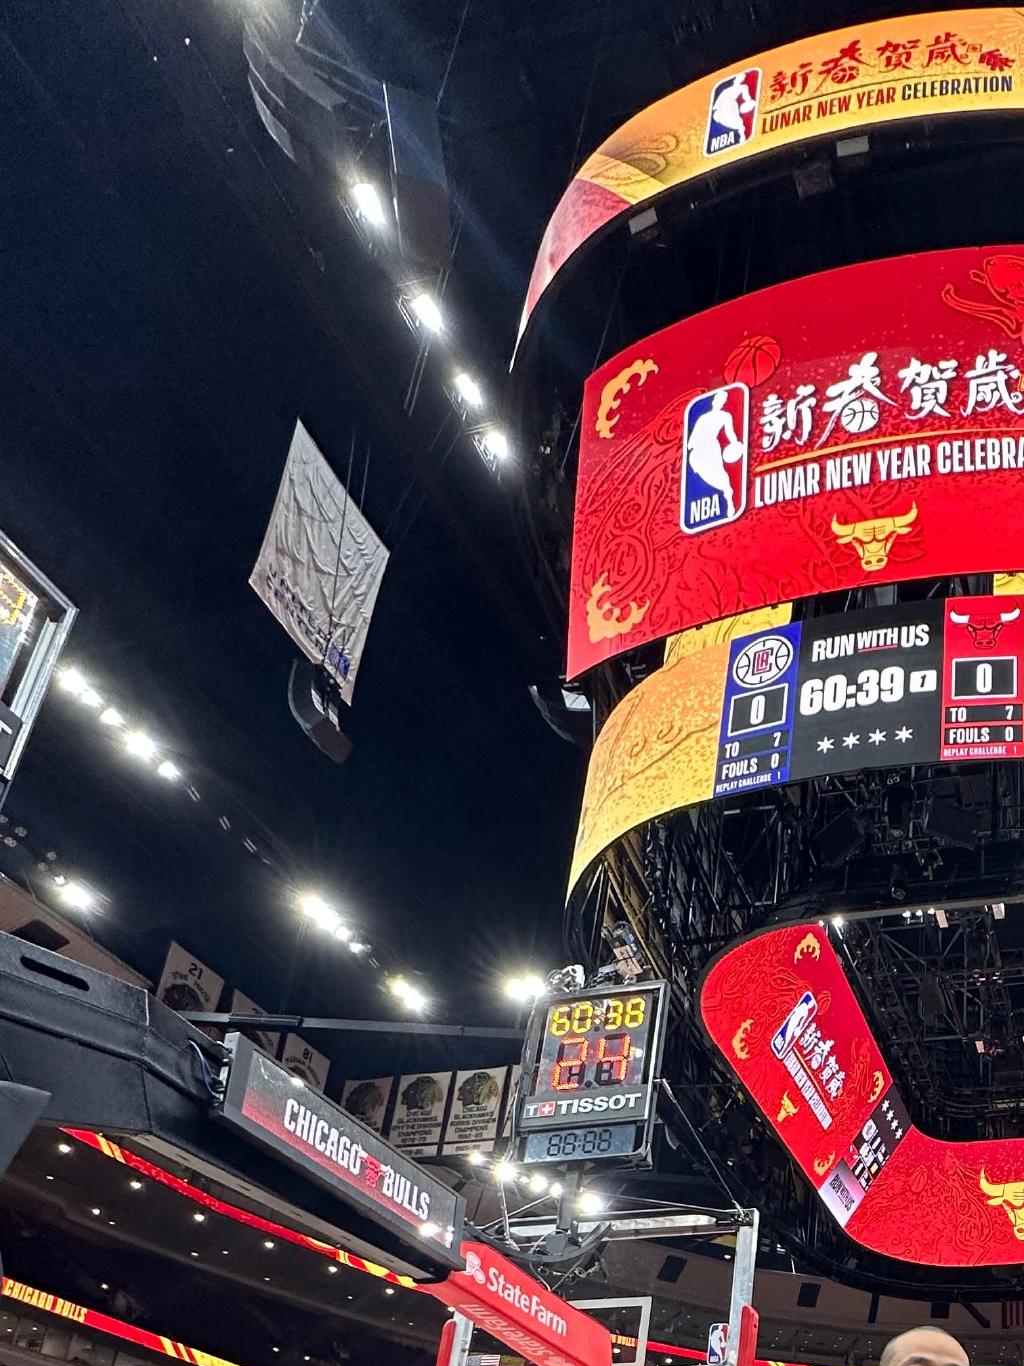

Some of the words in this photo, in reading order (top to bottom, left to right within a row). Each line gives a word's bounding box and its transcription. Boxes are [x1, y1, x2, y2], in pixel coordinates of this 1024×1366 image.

[761, 104, 811, 135] LUNAR
[817, 95, 851, 120] NEW
[857, 87, 895, 109] YEAR
[901, 75, 1014, 101] CELEBRATION
[710, 131, 735, 152] NBA
[754, 468, 821, 508] LUNAR
[825, 456, 874, 490] NEW
[878, 446, 932, 480] YEAR
[689, 494, 721, 525] NBA
[811, 634, 855, 662] RUN
[858, 627, 899, 651] WITH
[900, 624, 930, 648] US
[800, 666, 905, 716] 60:39
[976, 663, 993, 693] 0
[750, 695, 765, 725] 0
[950, 707, 966, 723] TO
[1005, 706, 1013, 720] 7
[724, 742, 740, 759] TO
[773, 732, 782, 747] 7
[949, 728, 990, 744] FOULS
[1006, 728, 1014, 742] 0
[722, 759, 757, 779] FOULS
[771, 752, 780, 769] 0
[943, 748, 968, 757] REPLAY
[969, 746, 1007, 756] CHALLENGE
[716, 782, 738, 793] REPLAY
[738, 774, 772, 788] CHALLENGE
[551, 1033, 632, 1092] 24
[557, 1093, 642, 1115] TISSOT
[283, 1098, 362, 1175] CHICAGO
[382, 1169, 430, 1221] BULLS
[3, 1279, 55, 1312] CHICAGO
[55, 1297, 88, 1323] BULLS
